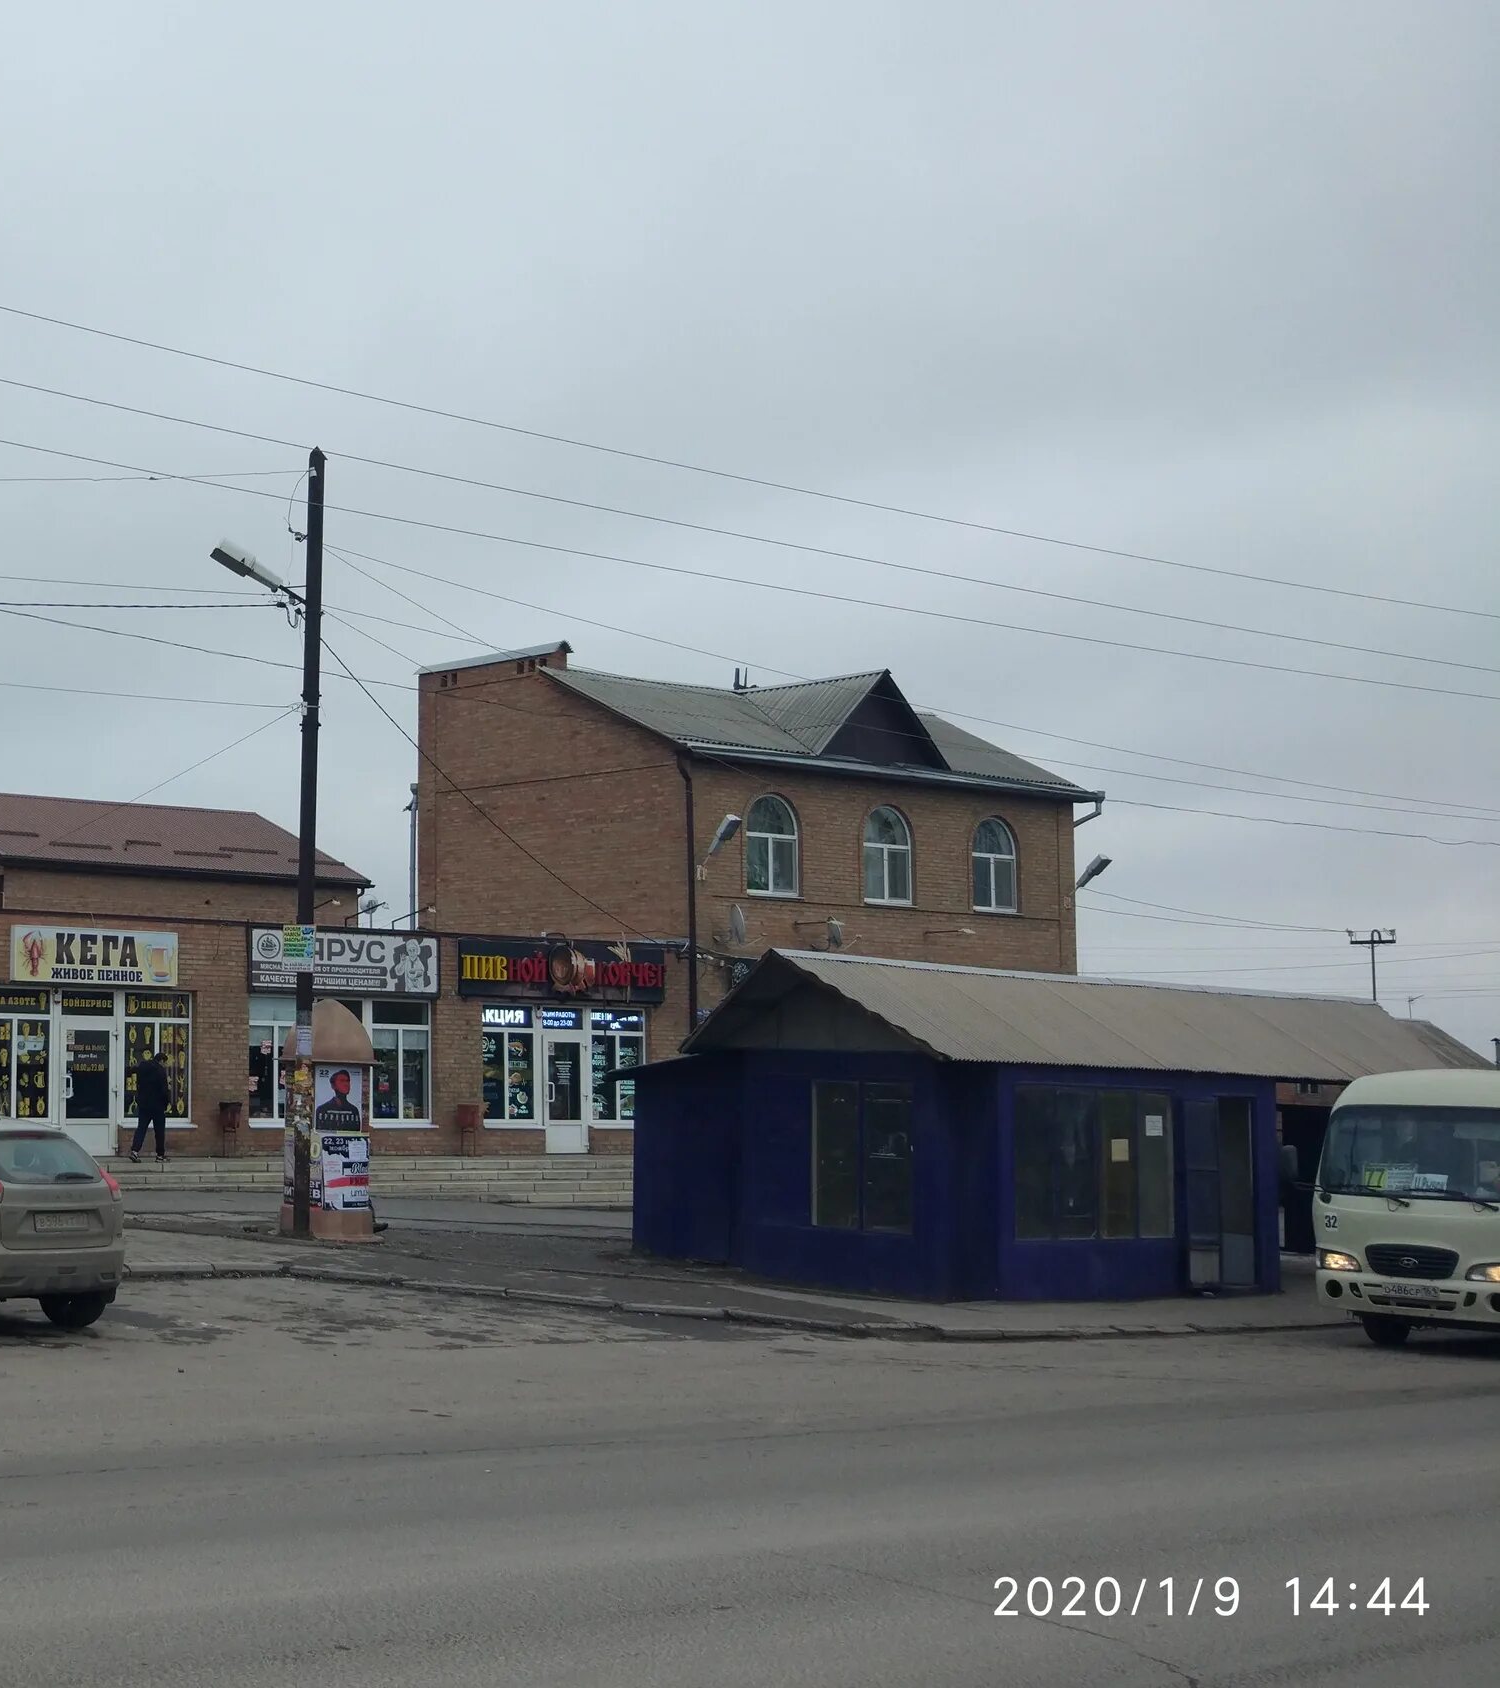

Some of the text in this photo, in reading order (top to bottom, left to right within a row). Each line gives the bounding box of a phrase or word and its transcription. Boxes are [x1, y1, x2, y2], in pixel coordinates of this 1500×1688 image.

[55, 932, 139, 968] КЕГА
[331, 966, 381, 976] ПРОИЗВОДИТЕЛЯ
[461, 952, 548, 983] ПИВНОЙ
[51, 967, 143, 983] ЖИВОЕ ПЕННОЕ
[8, 996, 36, 1006] АЗОТЕ
[62, 997, 113, 1009] БОЙЛЕРНОЕ
[141, 999, 173, 1010] ПЕННОЕ
[1325, 1215, 1338, 1229] 32
